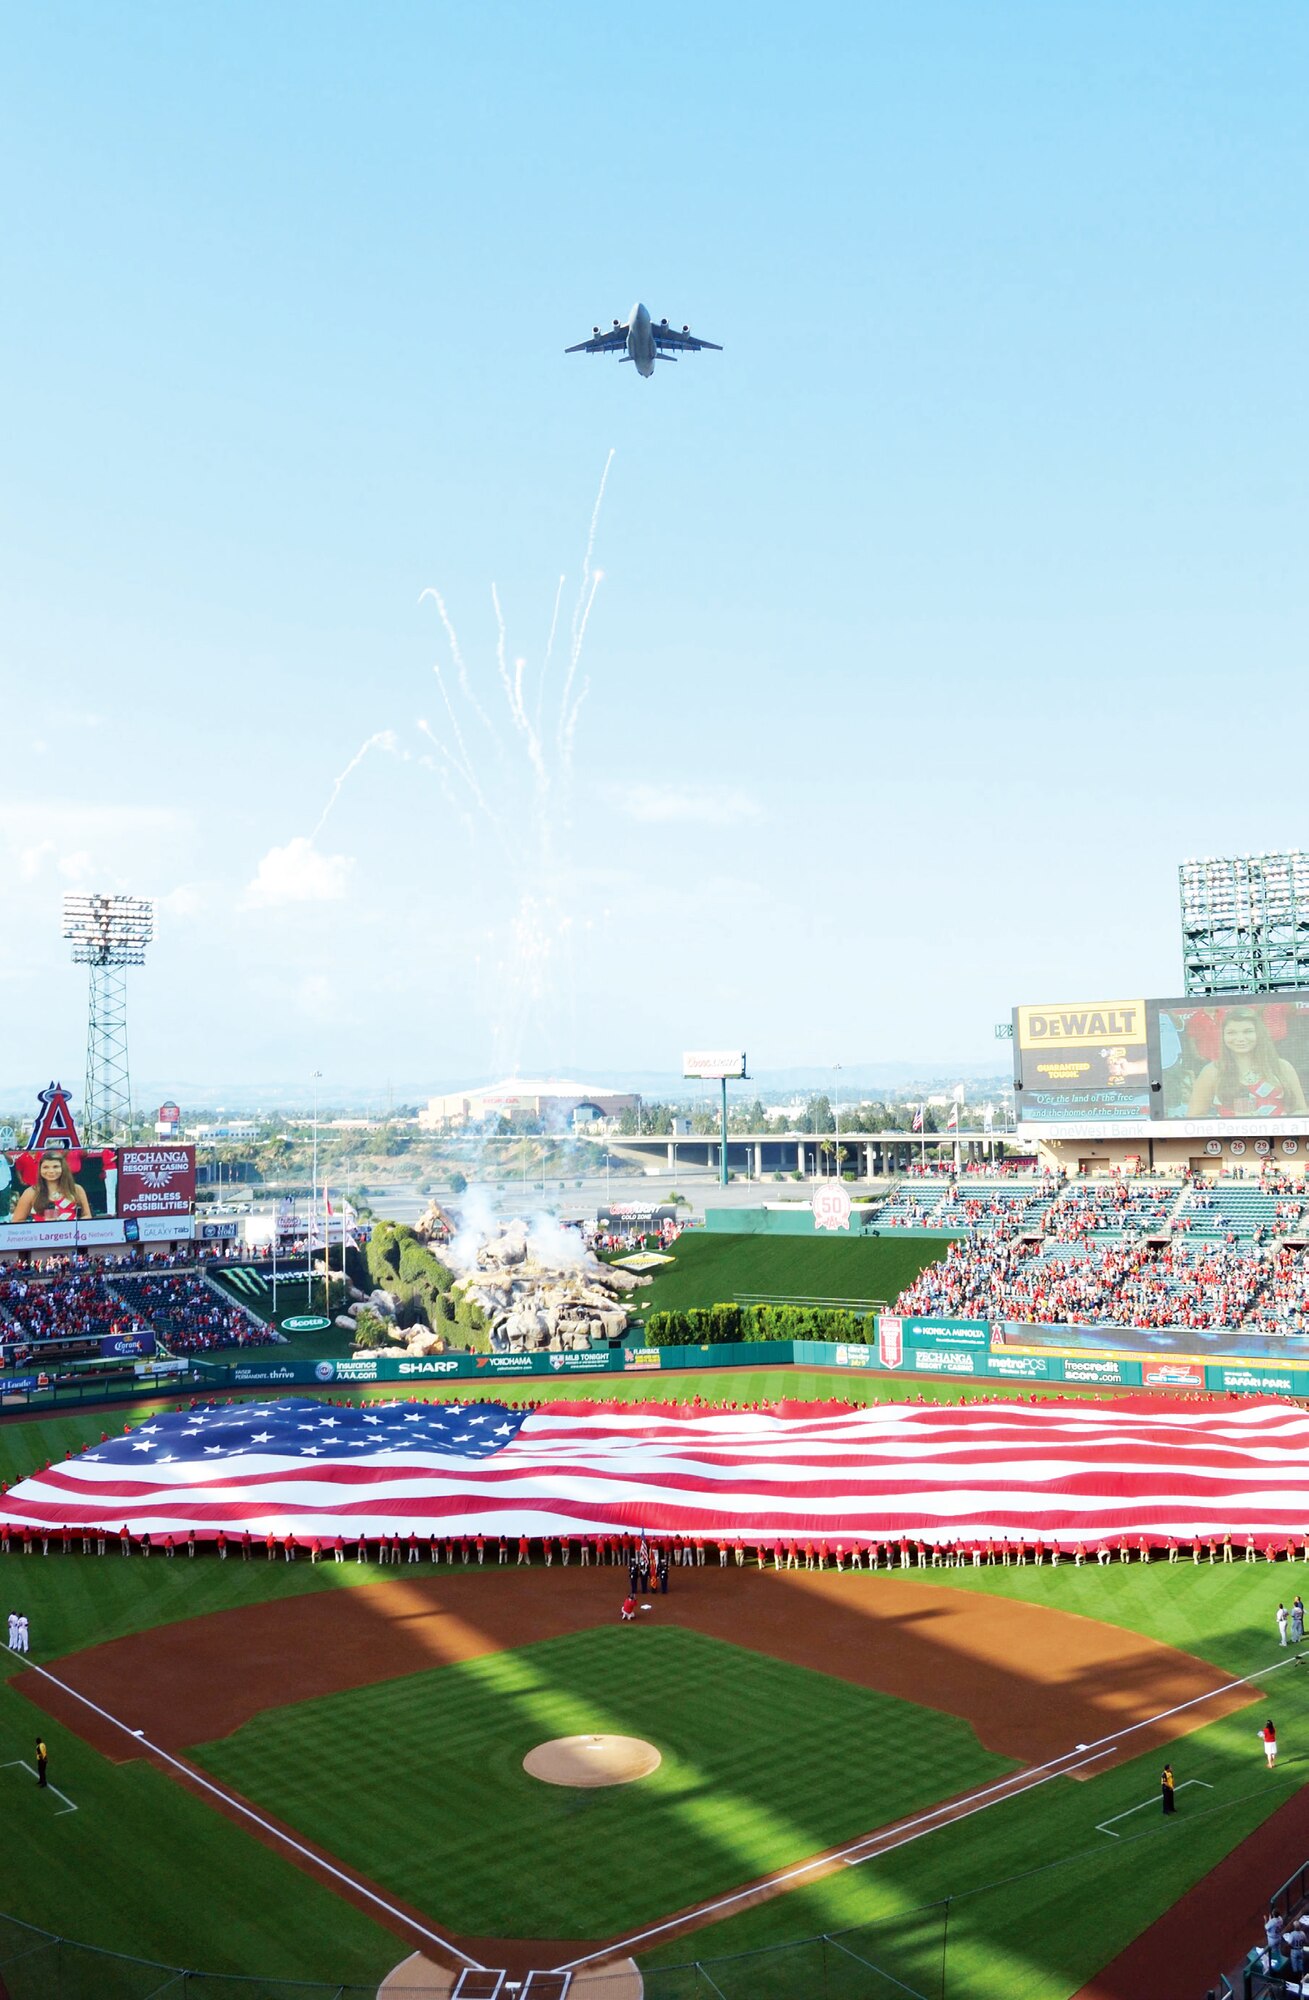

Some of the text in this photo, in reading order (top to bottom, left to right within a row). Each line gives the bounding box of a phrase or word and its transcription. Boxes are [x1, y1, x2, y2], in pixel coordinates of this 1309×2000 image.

[1071, 1094, 1089, 1103] land
[1091, 1093, 1101, 1102] of
[1116, 1092, 1134, 1101] free
[1064, 1108, 1086, 1116] home
[1111, 1123, 1144, 1136] Bank
[1184, 1122, 1214, 1135] One
[1217, 1121, 1268, 1135] Person
[1271, 1122, 1286, 1134] at
[1290, 1124, 1299, 1134] a
[123, 1151, 189, 1164] PECHANGA
[122, 1163, 189, 1172] RESORT CASINO
[123, 1200, 189, 1212] POSSIBILITIES
[173, 1226, 189, 1234] Tab
[39, 1231, 72, 1241] Largest
[289, 1319, 323, 1328] Scotts
[922, 1327, 985, 1338] KONICA MINOLTA
[489, 1357, 532, 1366] YOKOHAMA
[915, 1351, 974, 1365] PECHANGA
[336, 1361, 377, 1369] Insurance
[399, 1362, 457, 1374] SHARP
[269, 1369, 295, 1379] thrive
[336, 1372, 377, 1380] AAA.com
[1223, 1376, 1291, 1389] SAFARI PARK
